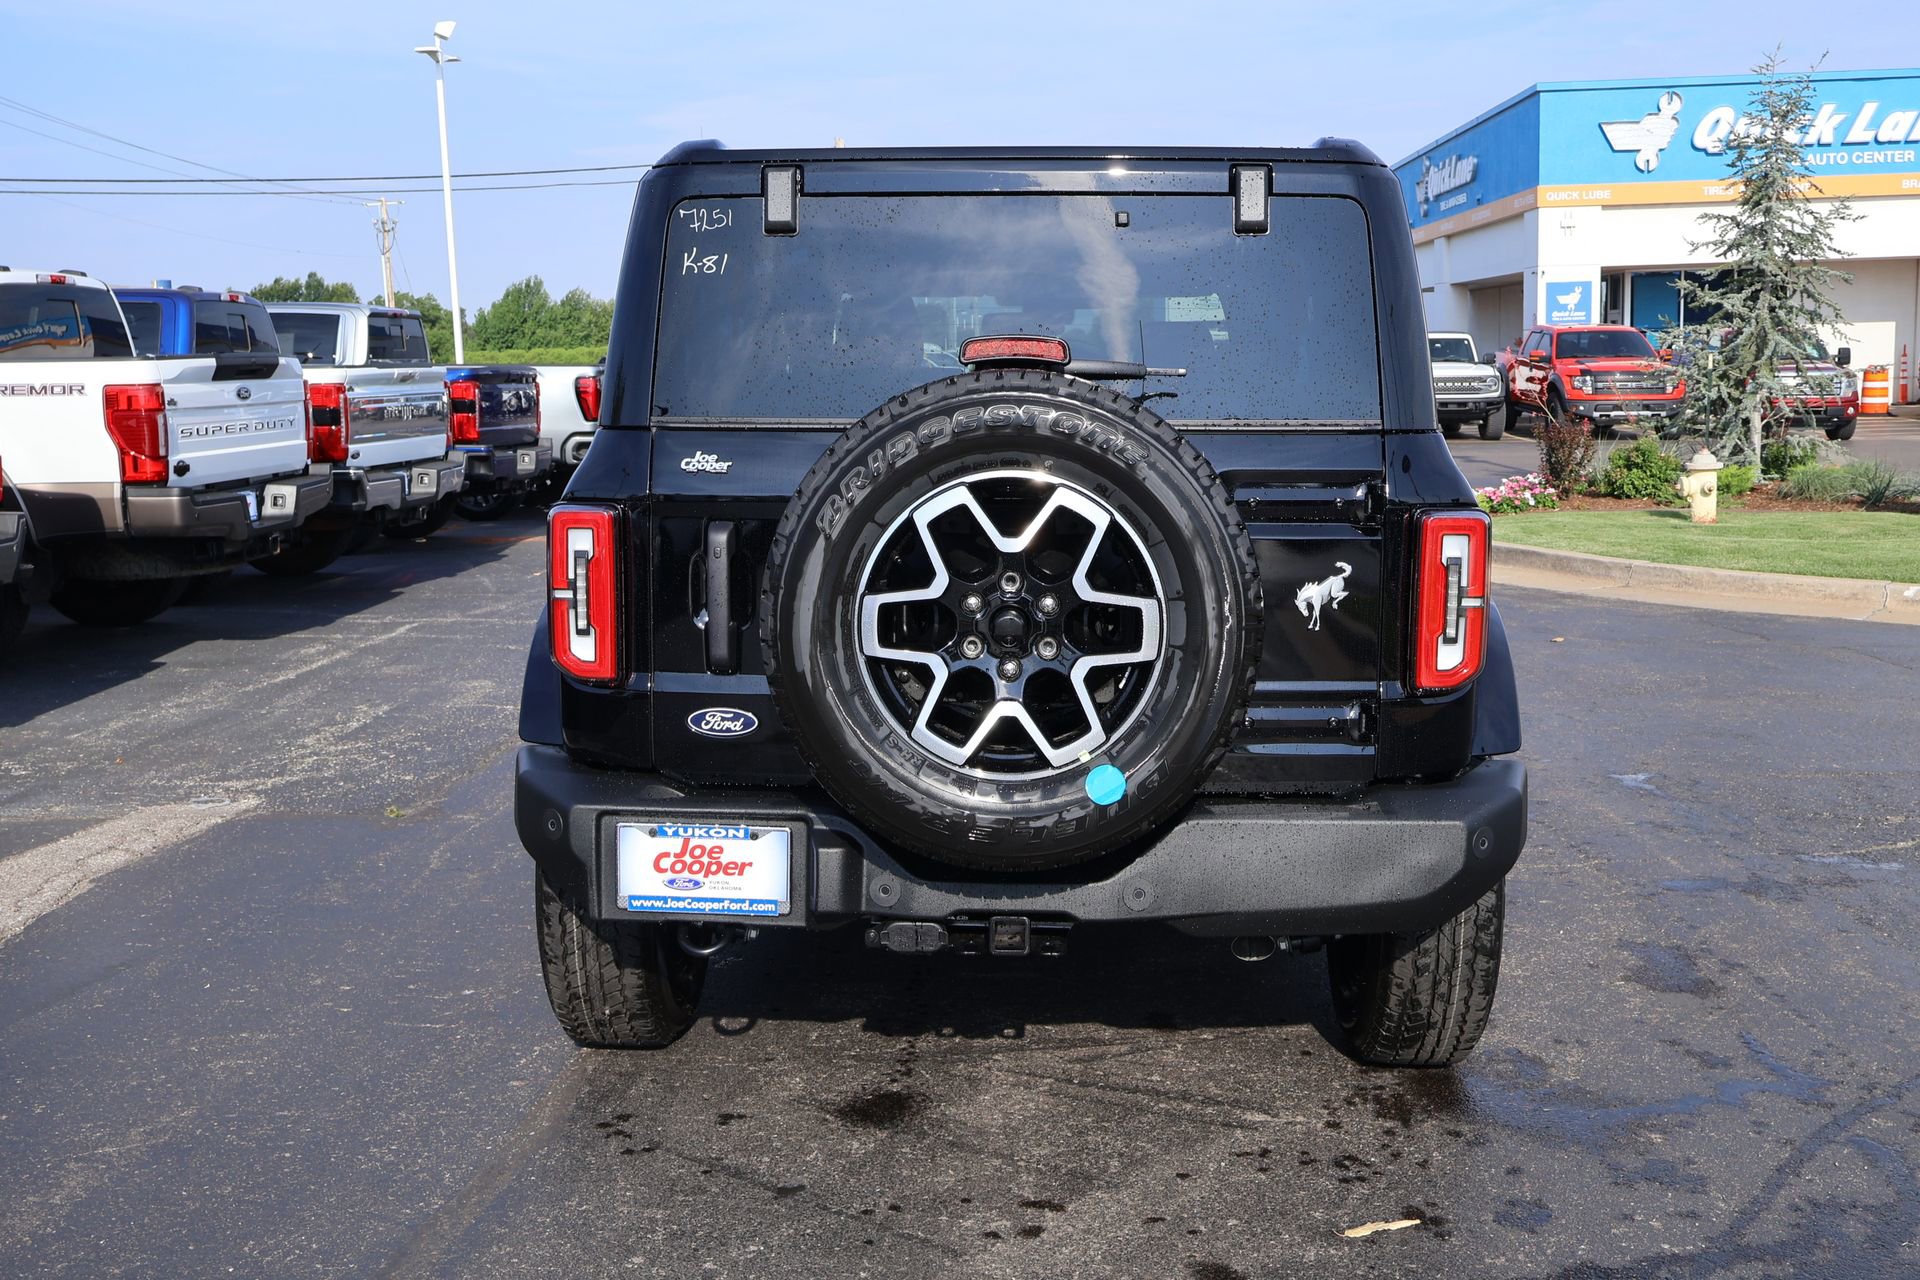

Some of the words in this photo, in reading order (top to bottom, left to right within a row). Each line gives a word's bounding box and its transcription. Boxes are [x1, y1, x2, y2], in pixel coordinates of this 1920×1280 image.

[1842, 102, 1920, 143] La
[1805, 152, 1848, 165] AUTO
[1852, 150, 1915, 164] CENTER
[1546, 191, 1580, 201] QUICK
[1582, 190, 1611, 200] LUBE
[679, 208, 732, 233] 7251
[682, 247, 728, 275] K-81
[180, 422, 249, 438] SUPER
[254, 417, 296, 431] DUTY
[681, 458, 732, 472] Cooper
[691, 450, 718, 462] Joe
[816, 404, 1152, 536] BRIDGESTONE
[701, 712, 744, 731] Ford
[662, 826, 746, 839] YUKON
[673, 838, 724, 860] Joe
[653, 851, 753, 878] Cooper
[631, 899, 776, 913] www.JoeCooperFord.com
